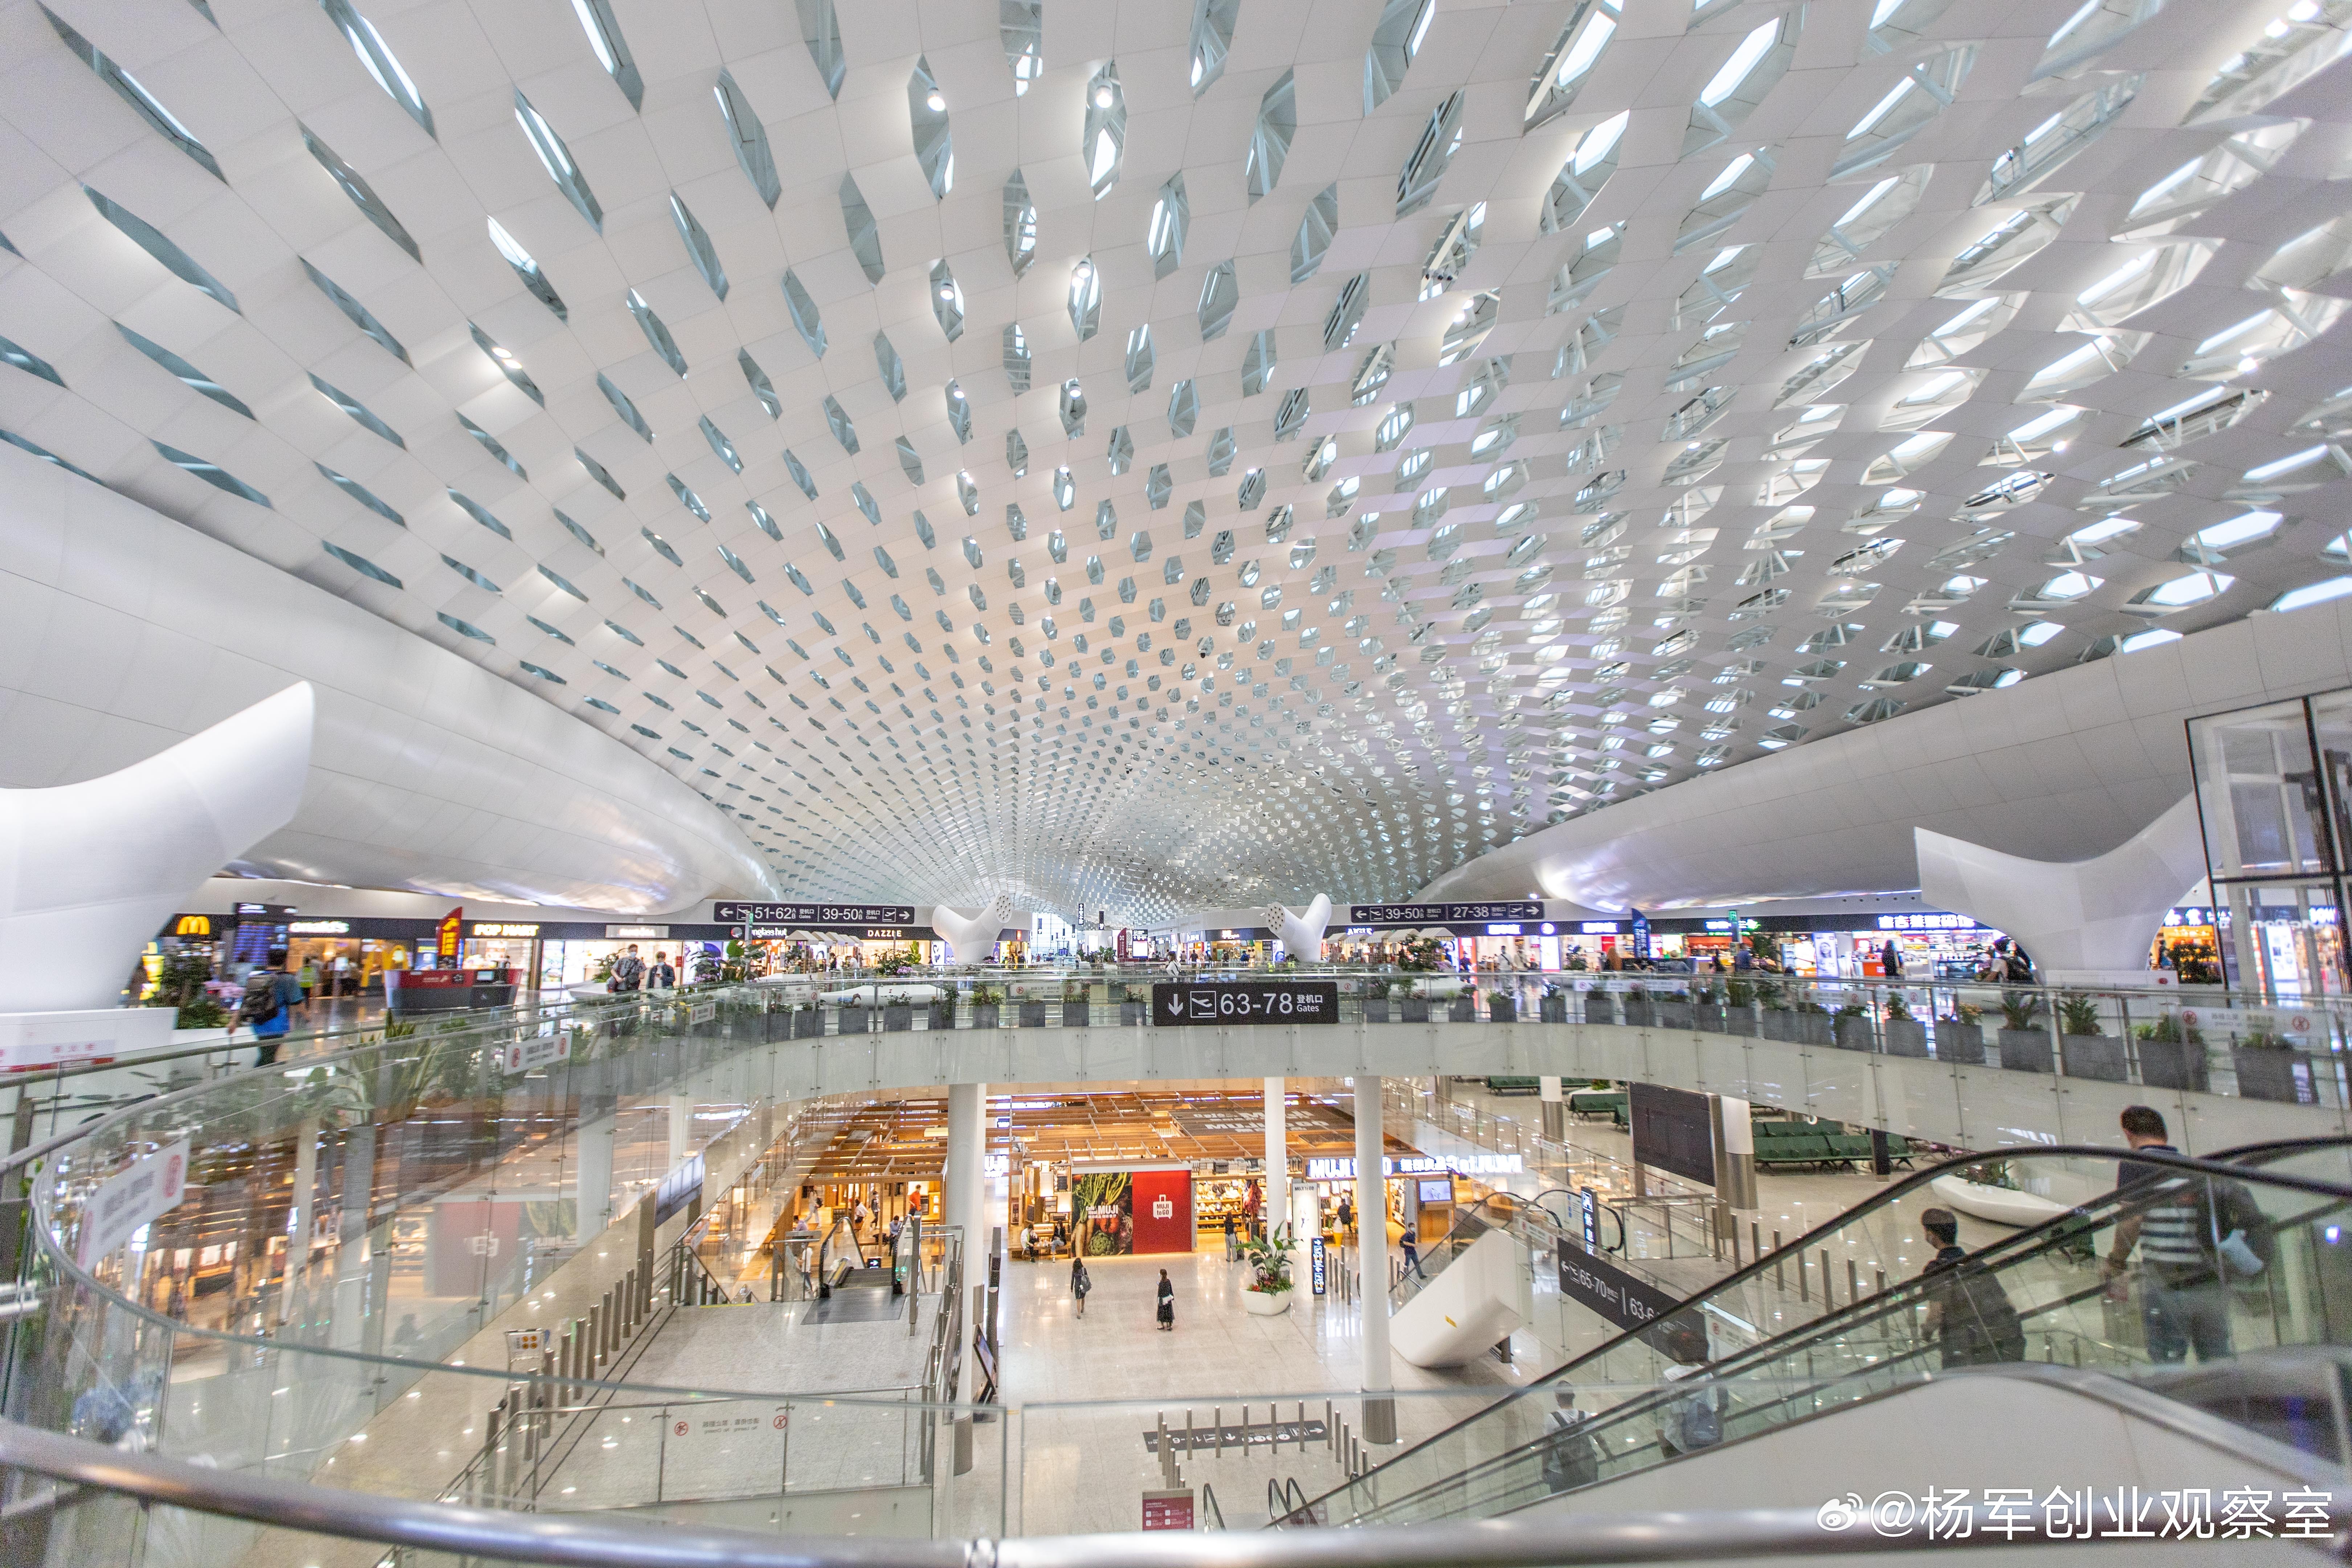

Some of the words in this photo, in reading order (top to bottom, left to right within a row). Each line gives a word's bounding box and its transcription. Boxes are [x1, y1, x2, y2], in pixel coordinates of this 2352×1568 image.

[755, 907, 791, 919] 51-62
[822, 908, 858, 920] 39-50
[1385, 908, 1420, 919] 39-50
[1453, 906, 1489, 918] 27-38
[473, 924, 502, 936] POP
[502, 924, 540, 936] MART
[751, 927, 775, 938] nglass
[1220, 993, 1293, 1014] 63-78
[1297, 995, 1323, 1004] 登机口
[1297, 1004, 1319, 1013] Gates
[1310, 1159, 1350, 1178] MUJI
[1098, 1205, 1118, 1214] MUJI
[1579, 1269, 1607, 1298] 65-70
[1630, 1298, 1661, 1320] 63-6
